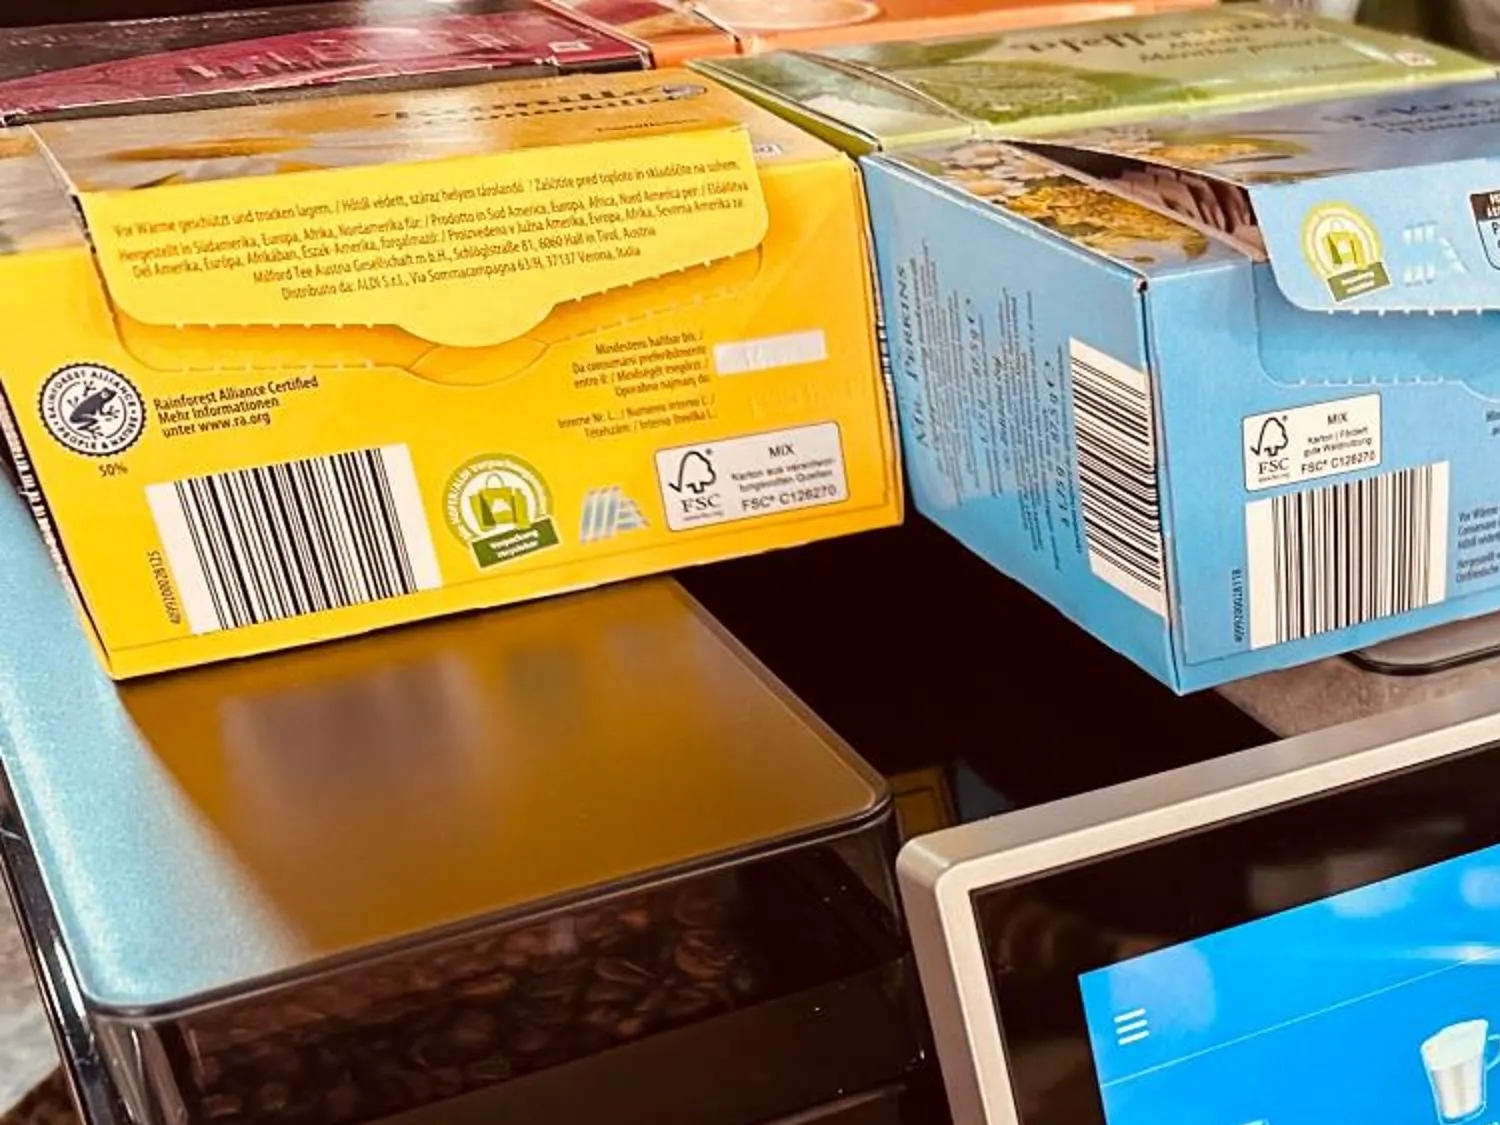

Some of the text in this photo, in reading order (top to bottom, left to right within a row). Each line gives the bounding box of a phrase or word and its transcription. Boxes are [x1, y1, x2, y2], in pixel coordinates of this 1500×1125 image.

[90, 370, 138, 407] ALLIANCE
[153, 376, 319, 411] Rainforest Alliance Certified
[158, 397, 280, 425] Mehr Informationen
[1327, 412, 1348, 425] MIX
[58, 424, 98, 451] PEOPLE
[110, 414, 140, 449] NATURE
[162, 411, 271, 439] unter www.ra.org
[768, 443, 795, 459] MIX
[98, 461, 128, 478] 50%
[1258, 458, 1290, 475] FSC
[681, 493, 721, 514] FSC
